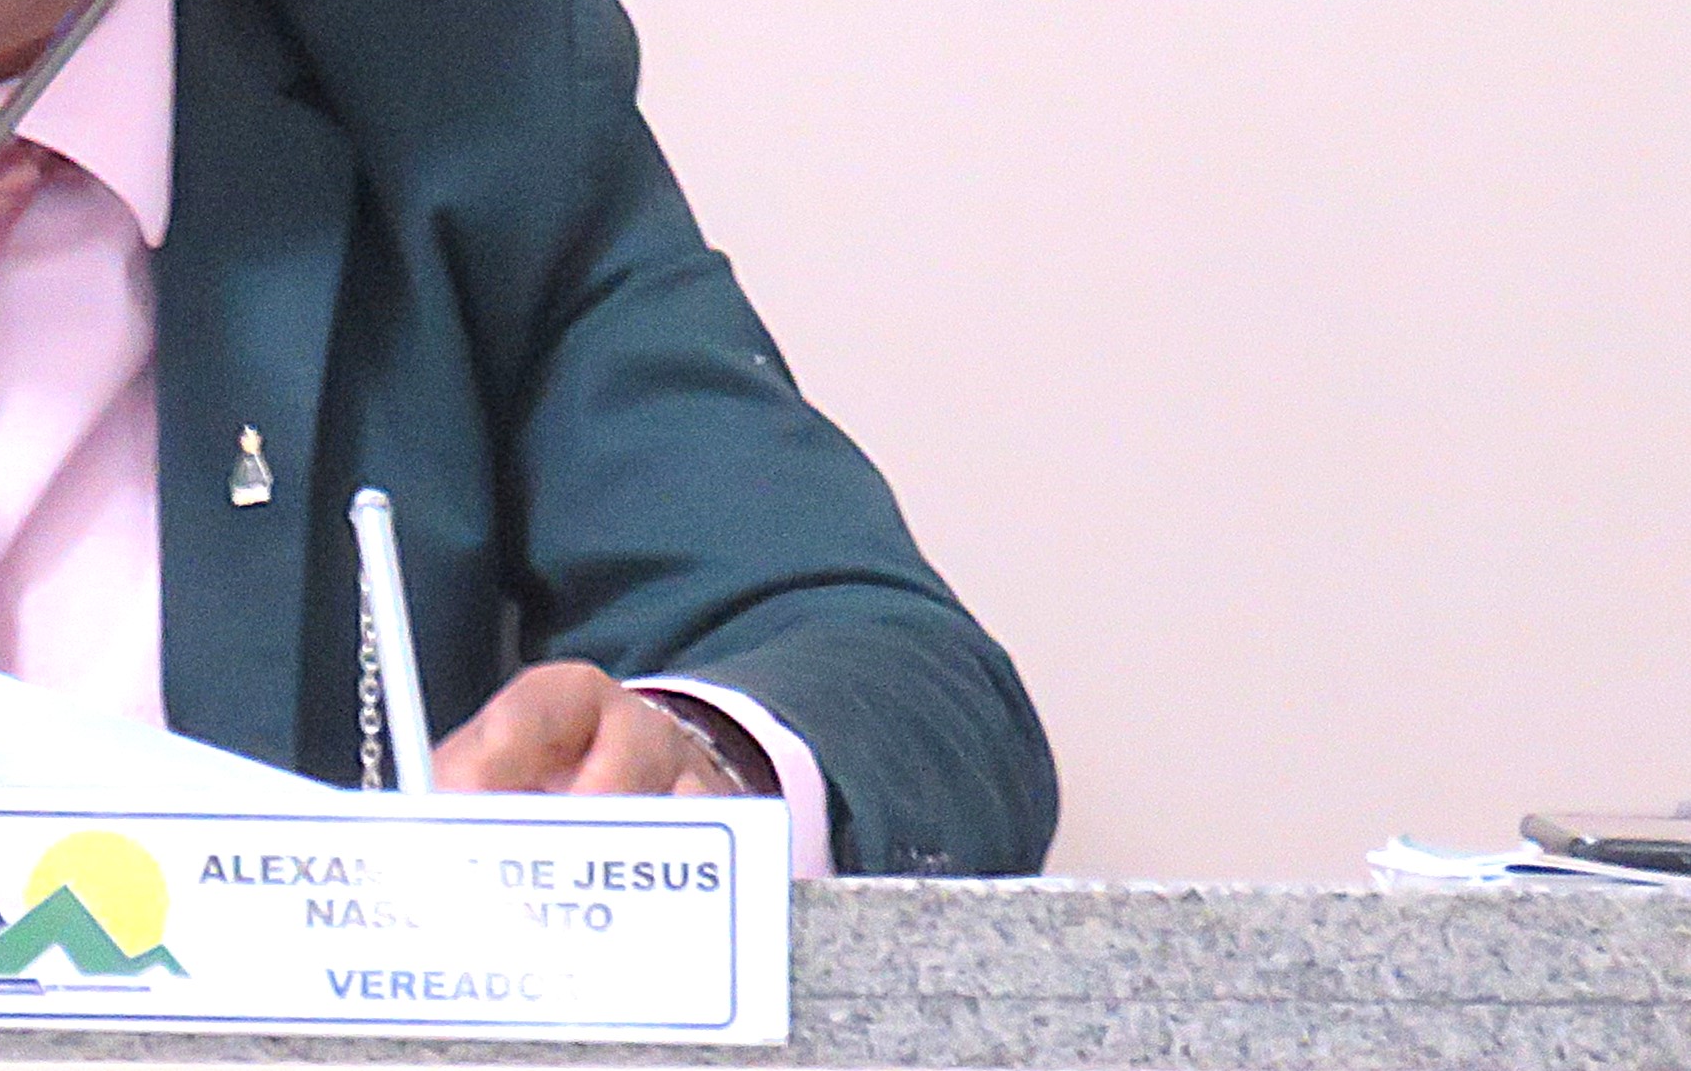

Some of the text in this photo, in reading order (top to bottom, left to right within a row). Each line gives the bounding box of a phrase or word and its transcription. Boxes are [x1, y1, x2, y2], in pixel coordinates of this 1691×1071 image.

[499, 859, 555, 890] DE
[572, 859, 721, 892] JESUS
[305, 898, 614, 932] NASNTO
